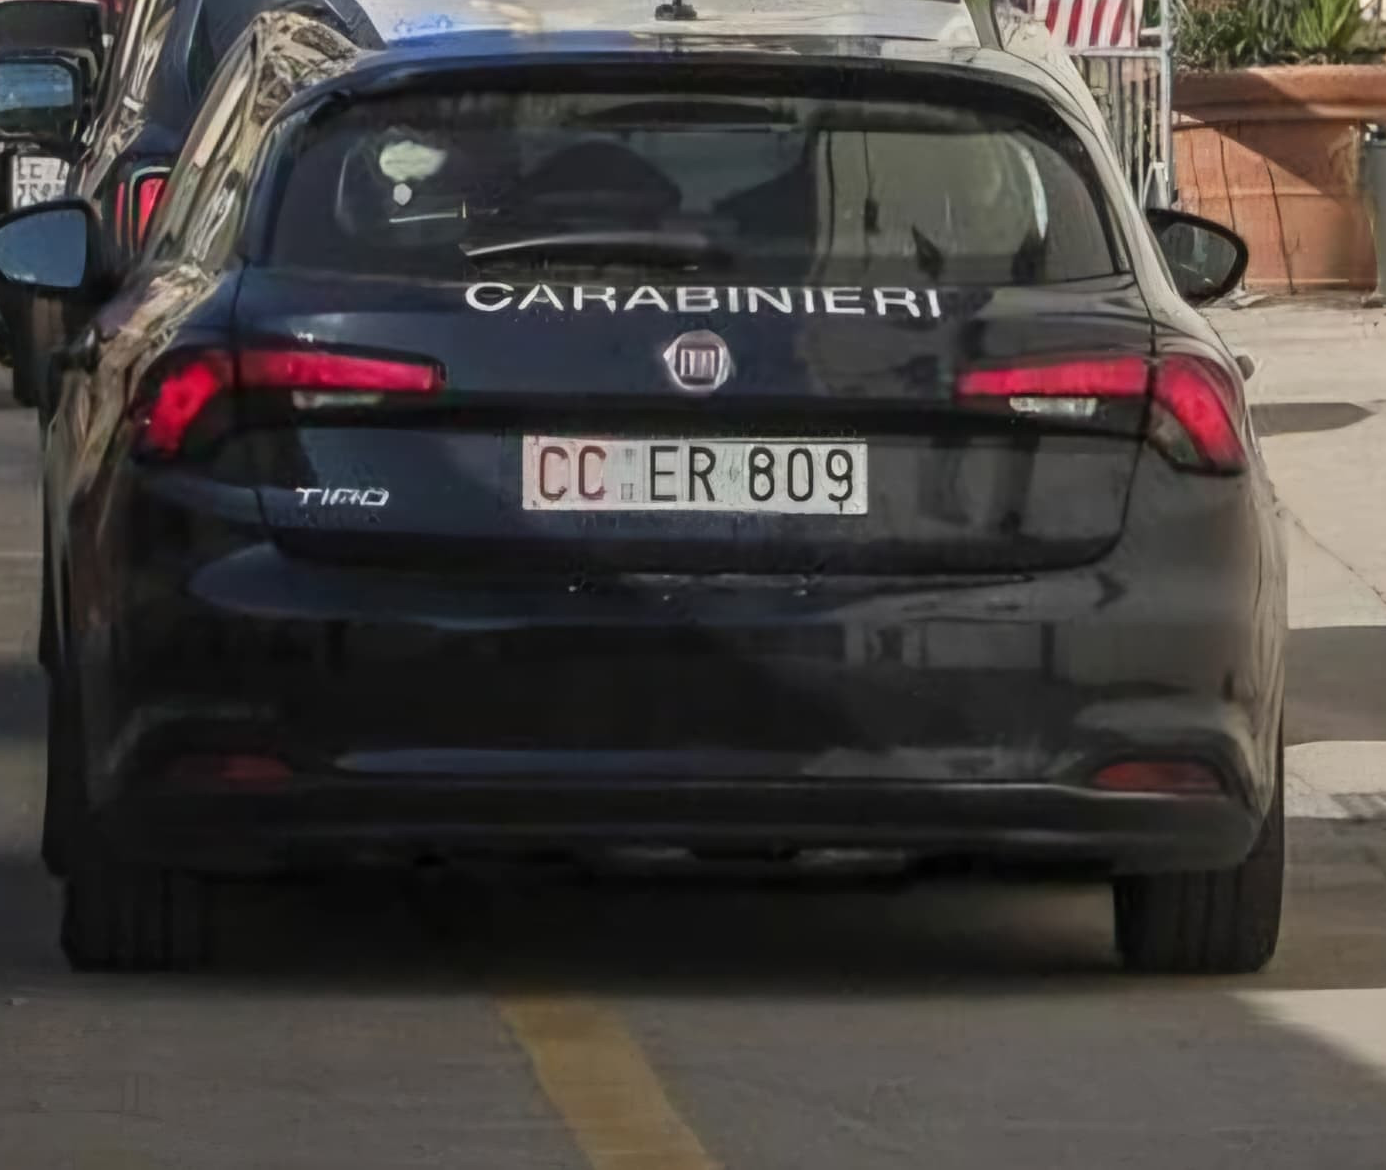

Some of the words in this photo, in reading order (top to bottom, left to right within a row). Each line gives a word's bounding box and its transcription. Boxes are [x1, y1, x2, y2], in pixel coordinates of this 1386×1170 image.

[465, 281, 942, 318] CARABINIERI
[538, 445, 607, 501] CC
[649, 445, 715, 502] ER
[748, 446, 855, 503] 809
